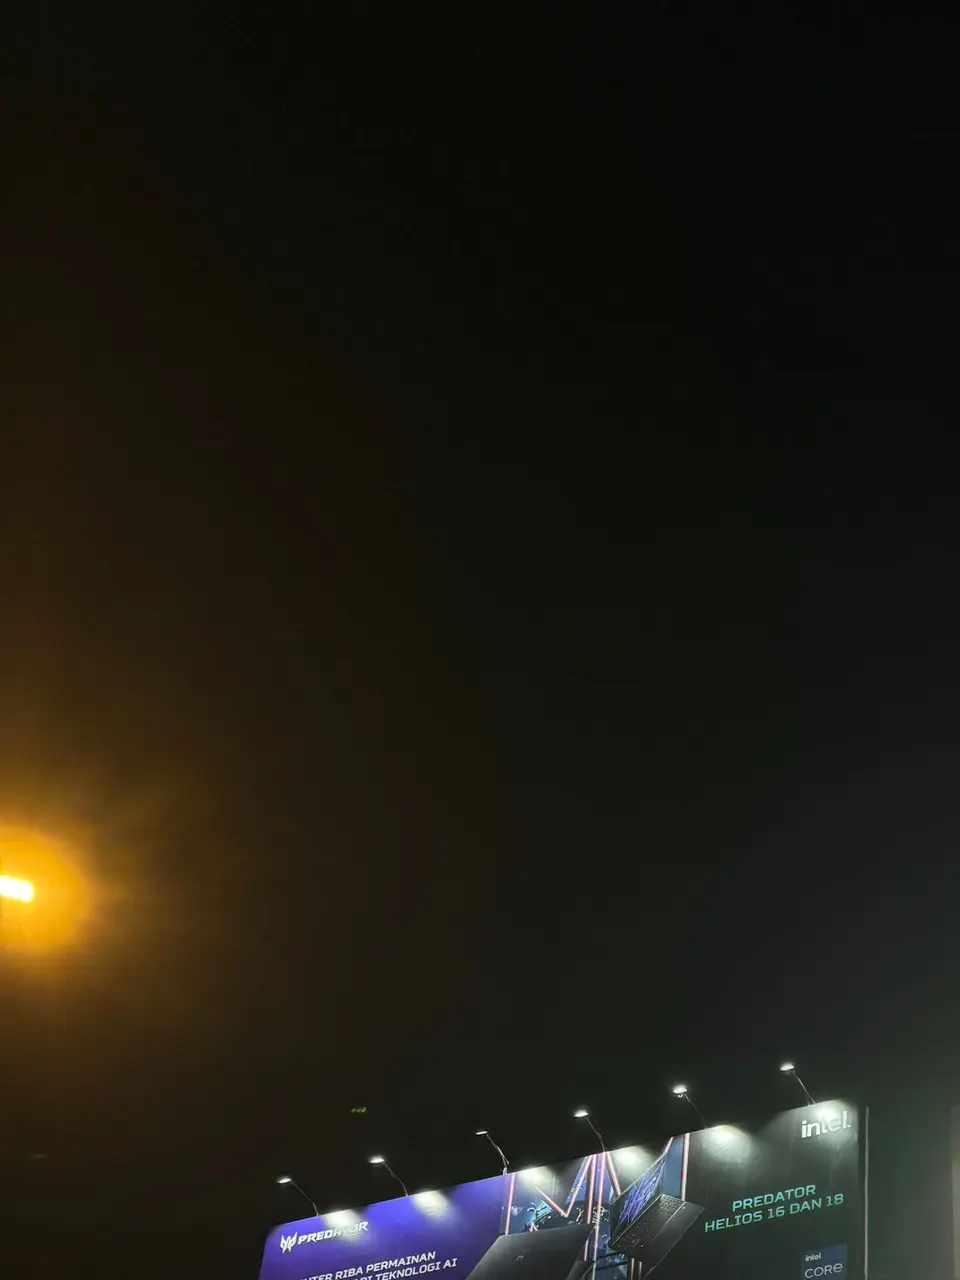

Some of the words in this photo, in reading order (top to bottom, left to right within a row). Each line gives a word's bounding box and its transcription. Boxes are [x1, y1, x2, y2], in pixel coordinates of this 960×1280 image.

[732, 1184, 816, 1212] PREDATOR
[704, 1210, 763, 1233] HELIOS
[767, 1206, 785, 1219] 16
[789, 1197, 822, 1215] DAN
[826, 1193, 844, 1206] 18
[335, 1267, 364, 1280] RIBA
[366, 1251, 436, 1273] PERMAINAN
[443, 1258, 458, 1269] AI
[805, 1252, 822, 1262] intel
